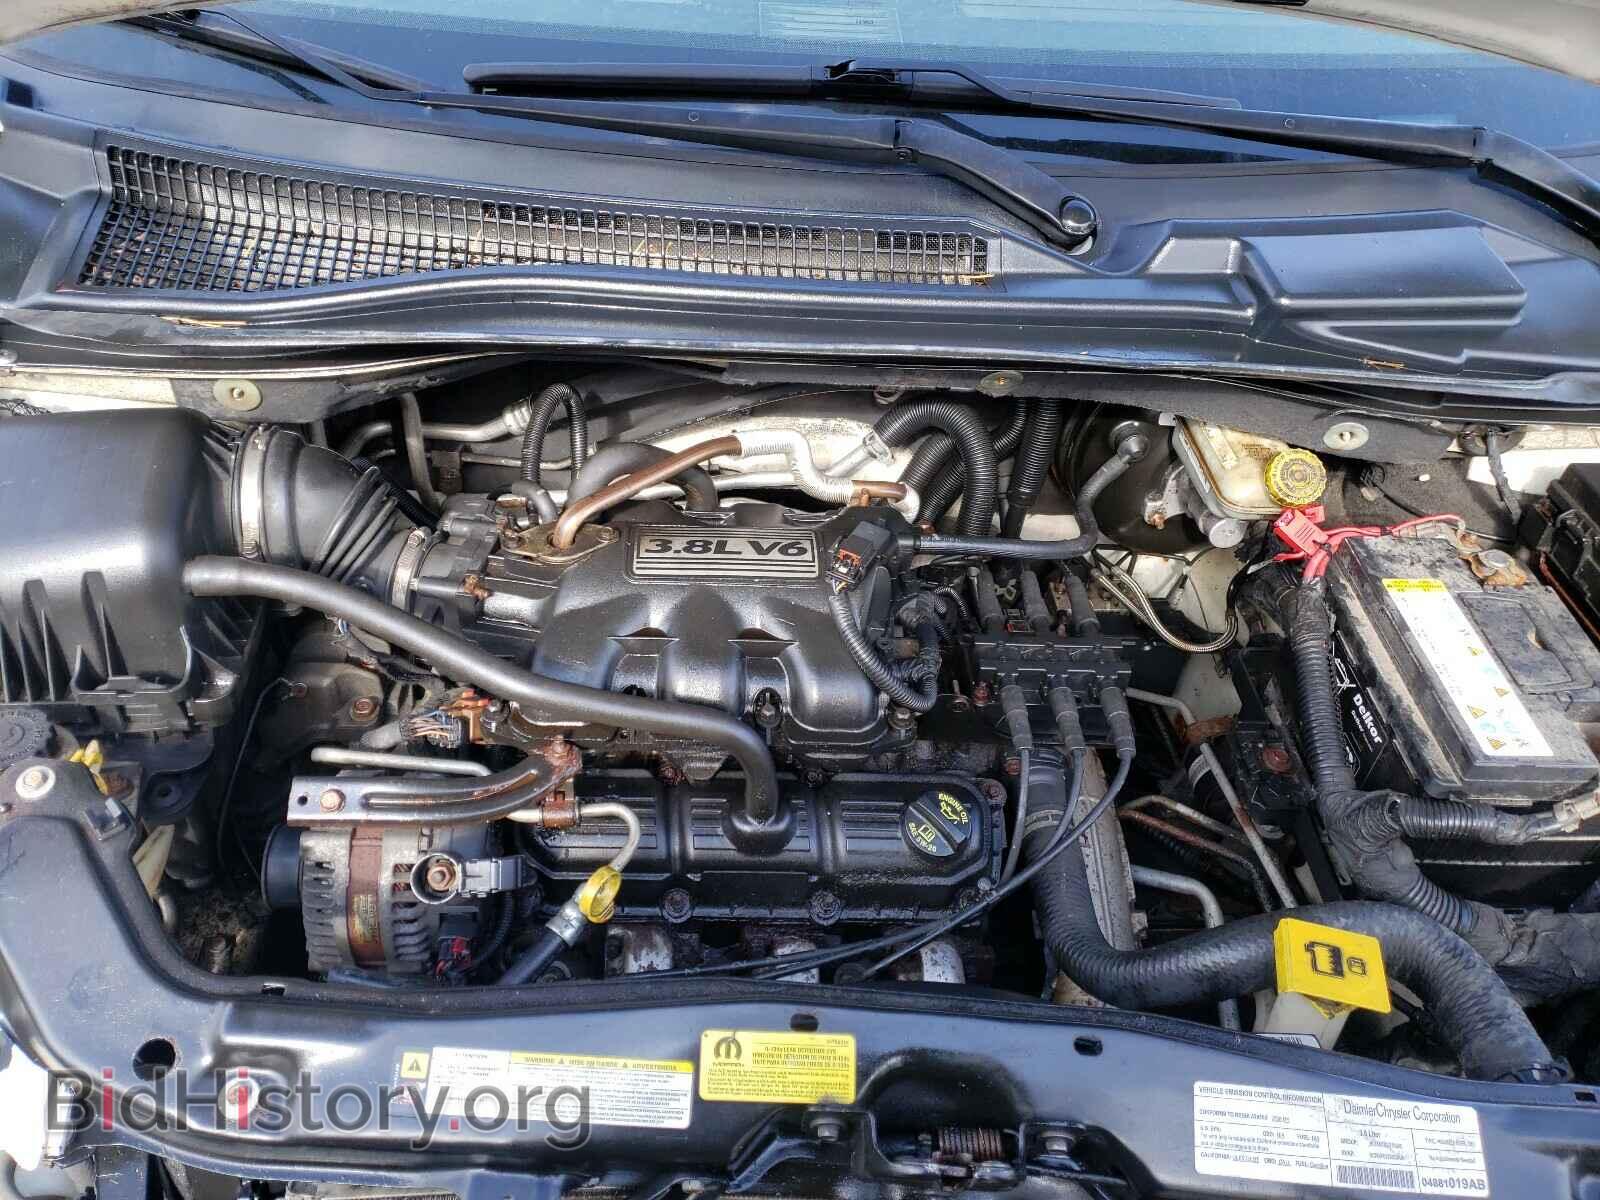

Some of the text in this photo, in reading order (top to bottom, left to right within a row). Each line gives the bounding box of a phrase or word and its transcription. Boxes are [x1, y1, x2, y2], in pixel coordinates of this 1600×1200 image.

[645, 538, 808, 556] 3.8L V6
[1353, 693, 1383, 743] Delkor
[938, 793, 969, 825] ENGINE OIL
[1343, 1099, 1461, 1124] DaimlerChrysler Corporation
[1421, 1178, 1486, 1190] 04881019AB
